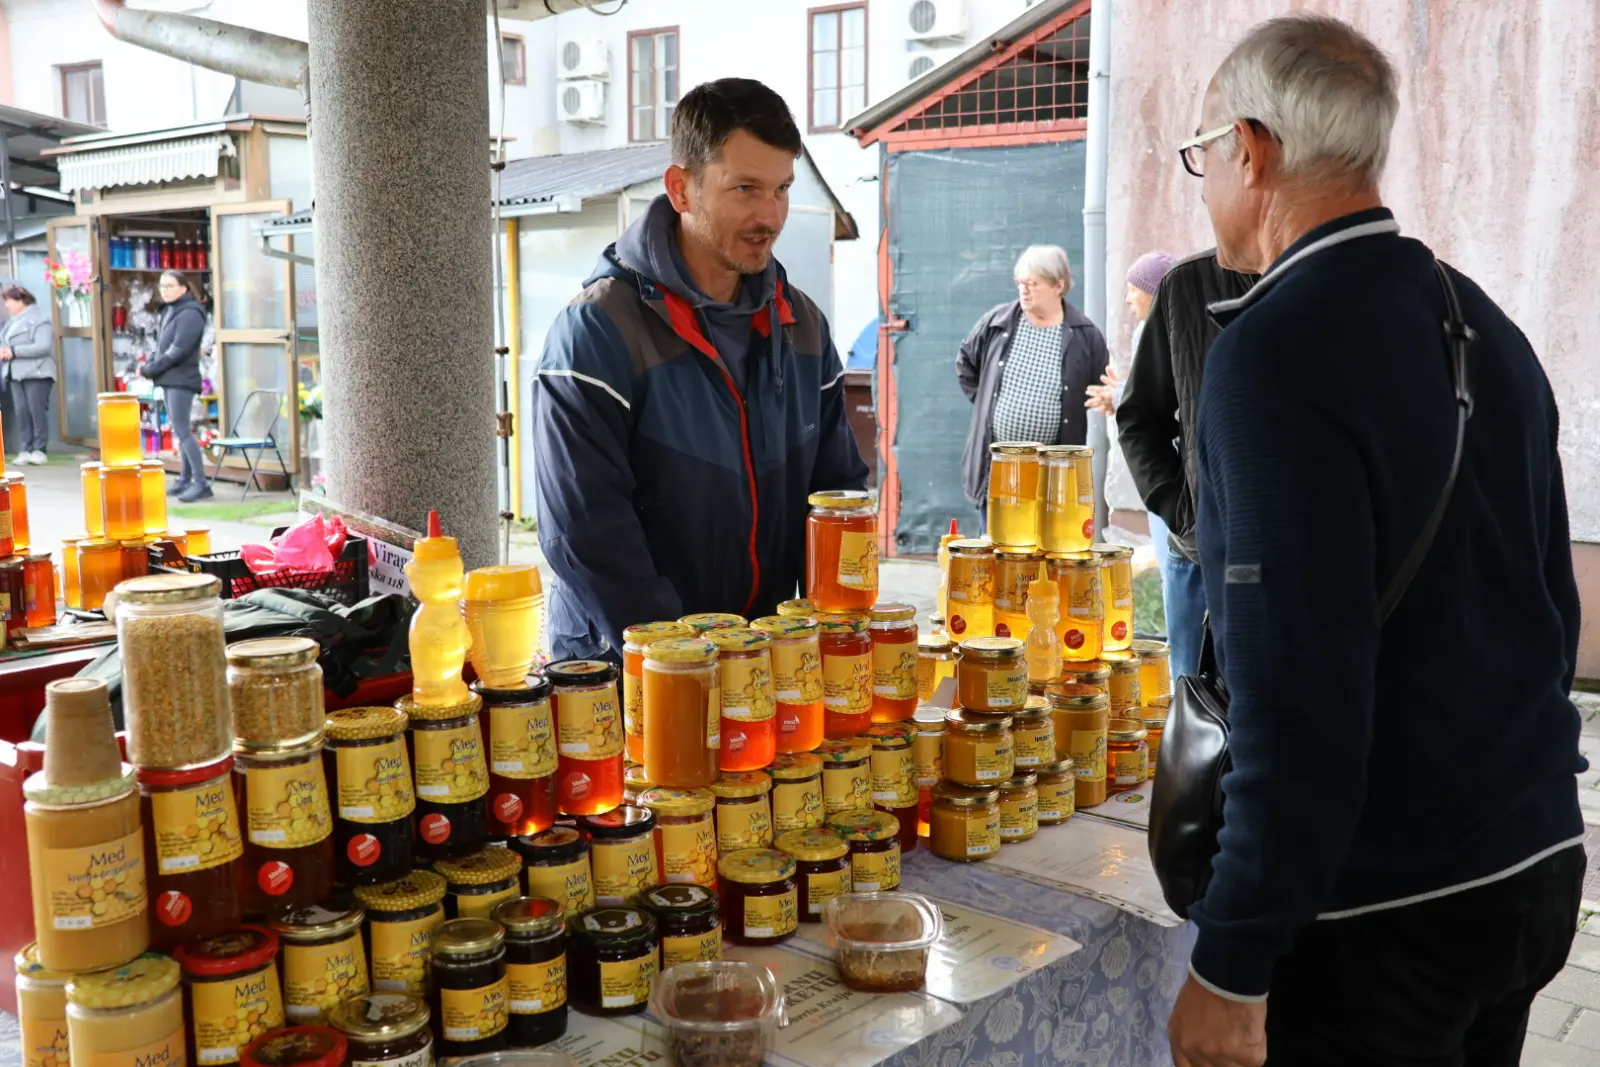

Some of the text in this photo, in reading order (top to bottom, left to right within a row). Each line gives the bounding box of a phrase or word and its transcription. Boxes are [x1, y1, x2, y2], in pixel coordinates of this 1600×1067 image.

[592, 699, 614, 714] Med
[527, 715, 549, 731] Med
[195, 785, 224, 808] Med
[89, 844, 126, 868] Med
[628, 848, 650, 866] Med
[566, 871, 587, 889] Med
[327, 948, 354, 970] Med
[235, 975, 266, 999] Med
[136, 1044, 170, 1067] Med
